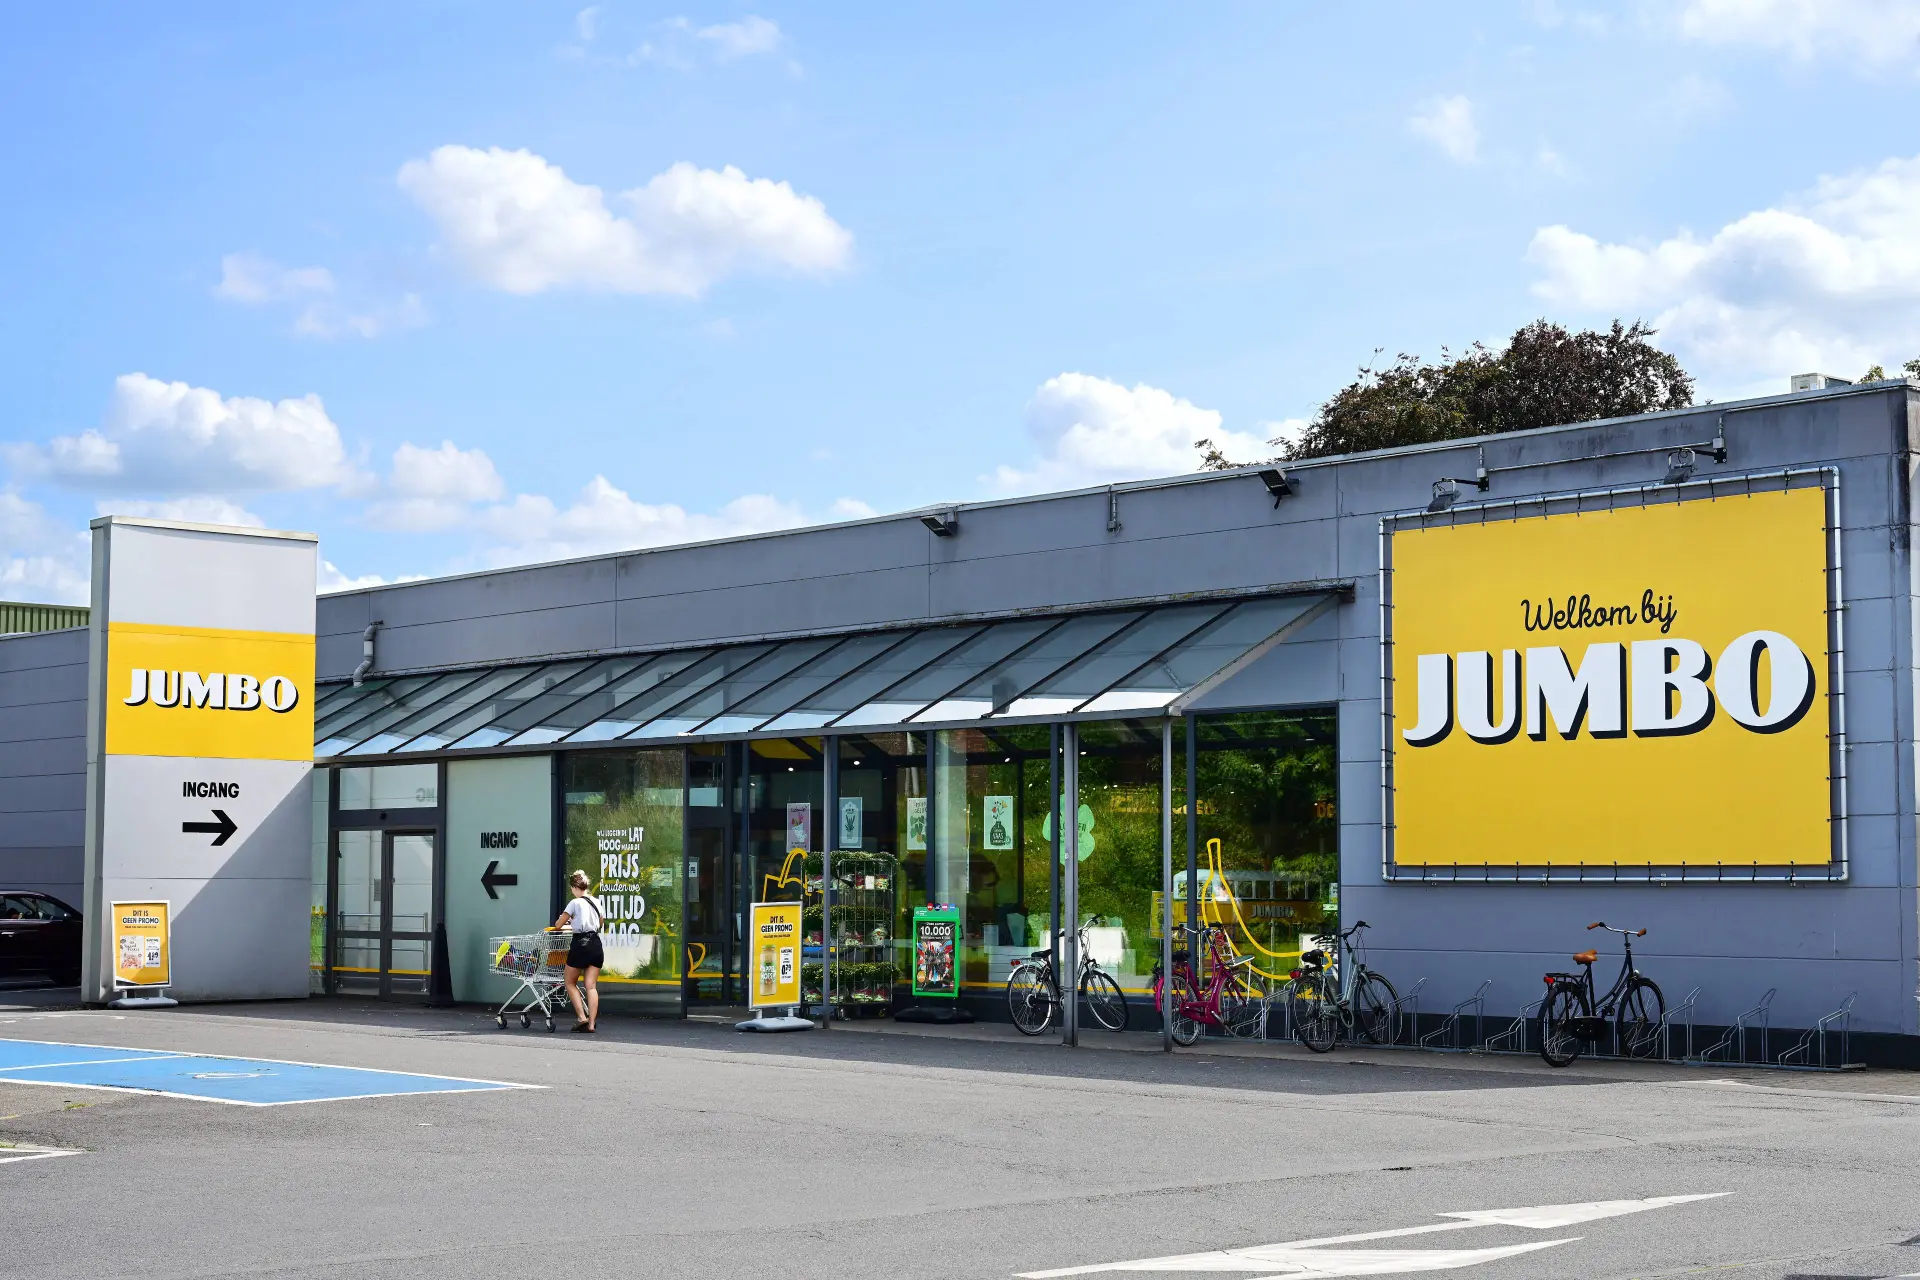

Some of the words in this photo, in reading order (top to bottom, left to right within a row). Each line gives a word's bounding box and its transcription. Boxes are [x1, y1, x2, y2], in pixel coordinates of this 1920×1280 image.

[1520, 594, 1637, 632] Welkom
[1641, 588, 1678, 634] bij
[123, 668, 299, 713] JUMBO
[1402, 629, 1816, 748] JUMBO
[182, 781, 240, 799] INGANG
[480, 832, 518, 848] INGANG
[628, 826, 644, 842] LAT
[598, 839, 621, 851] HOOG
[600, 853, 640, 878] PRIJS
[599, 879, 627, 892] houden
[628, 883, 640, 892] we
[599, 894, 645, 920] ALTIJD
[1251, 905, 1294, 918] JUMBO
[770, 915, 778, 923] DIT
[780, 915, 784, 923] IS
[775, 924, 793, 932] PROMO
[920, 926, 951, 936] 10.000
